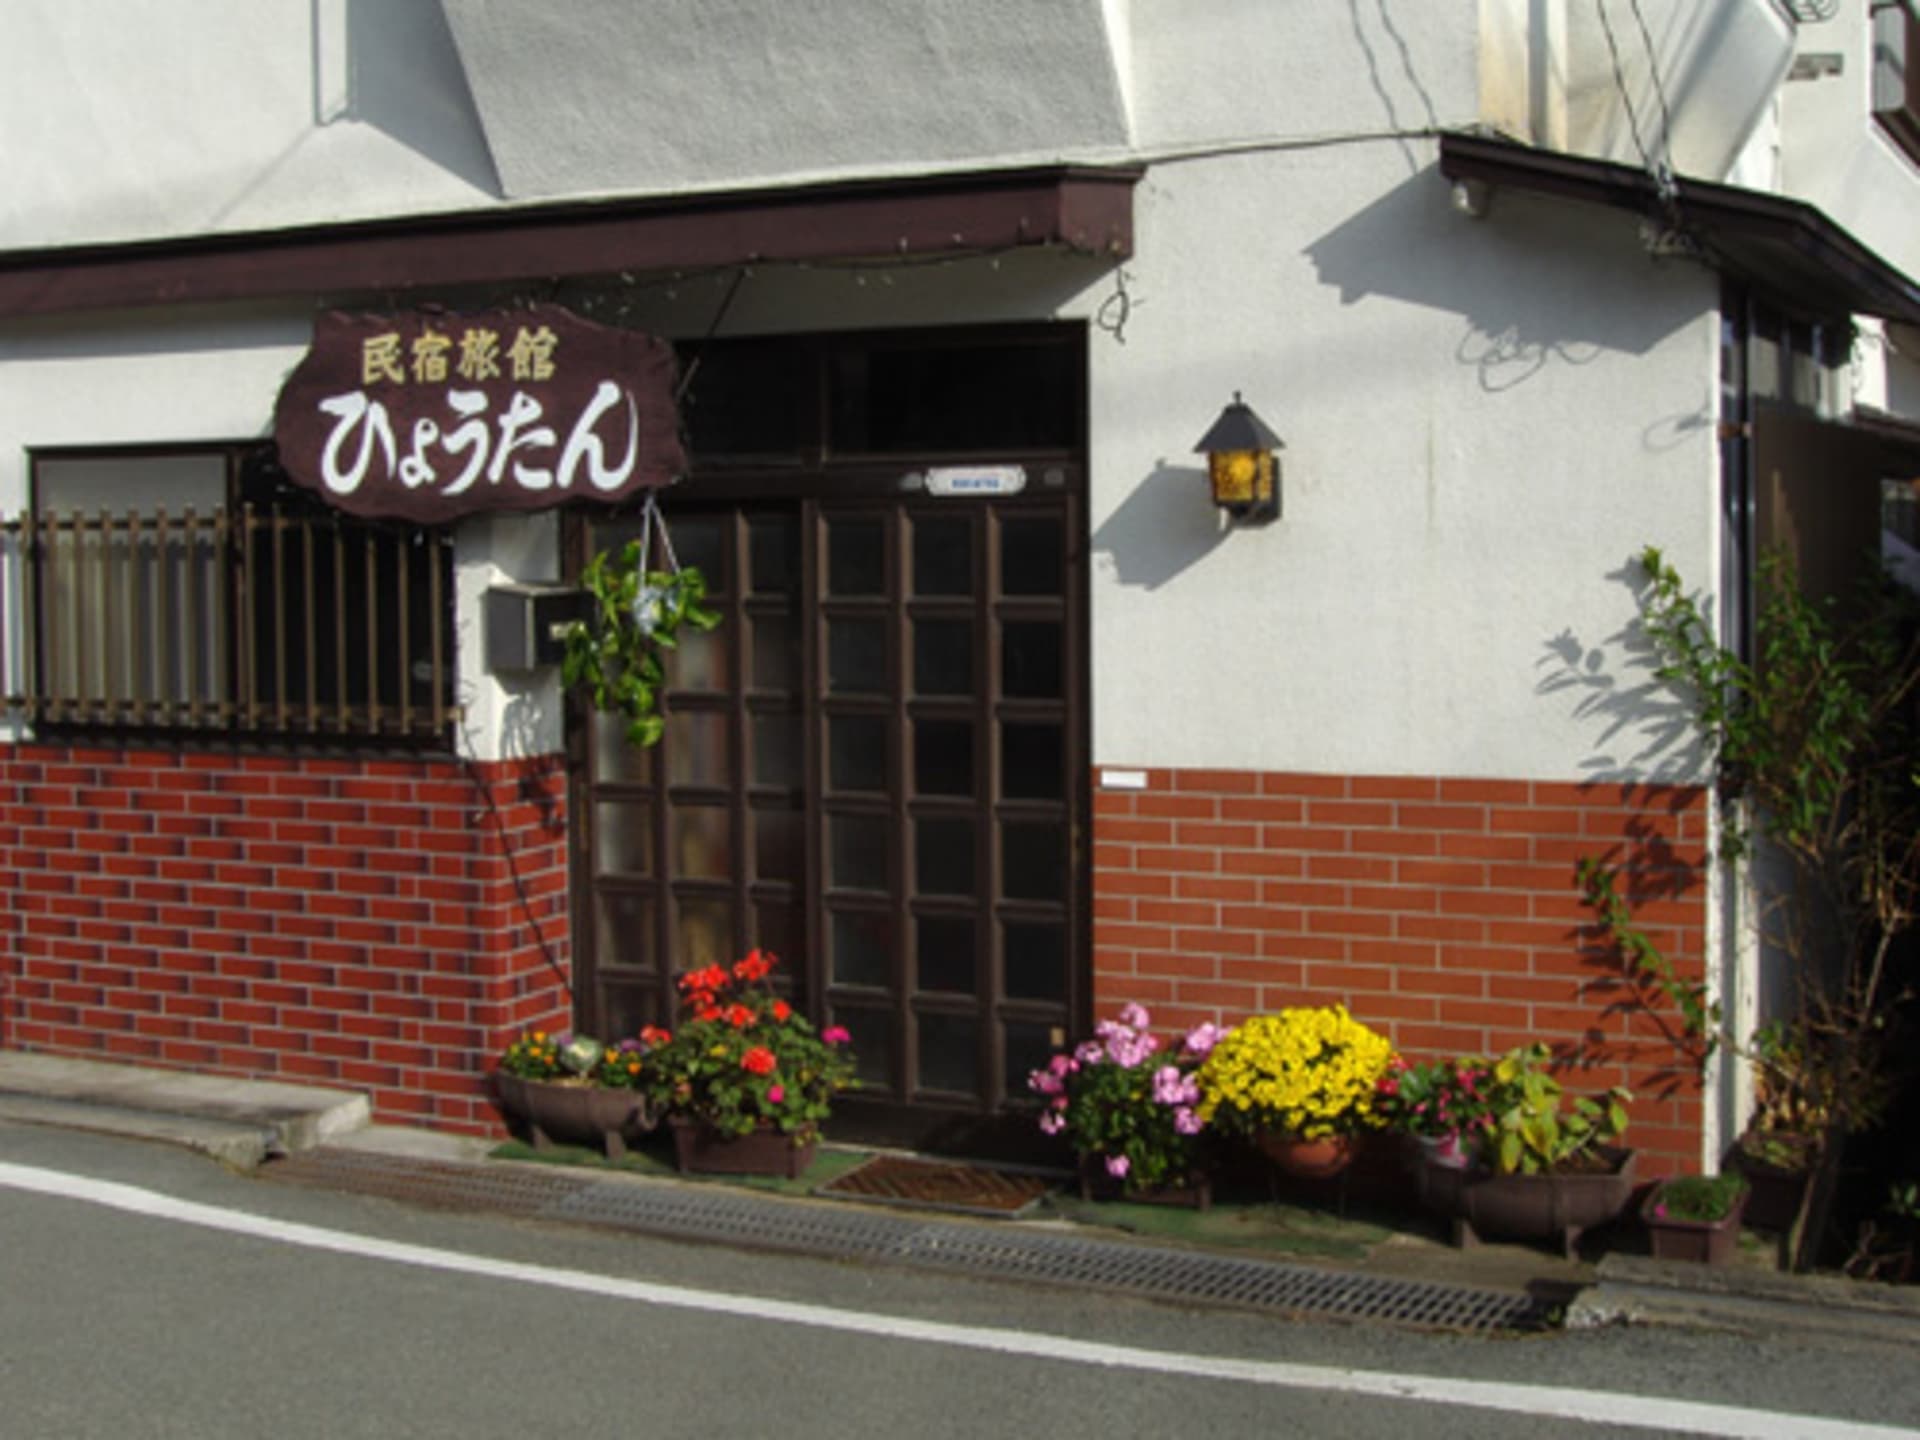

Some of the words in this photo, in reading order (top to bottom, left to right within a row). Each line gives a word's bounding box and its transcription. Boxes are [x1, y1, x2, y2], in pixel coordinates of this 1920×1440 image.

[362, 326, 559, 385] 民宿旅館
[318, 380, 639, 495] ひょうたん
